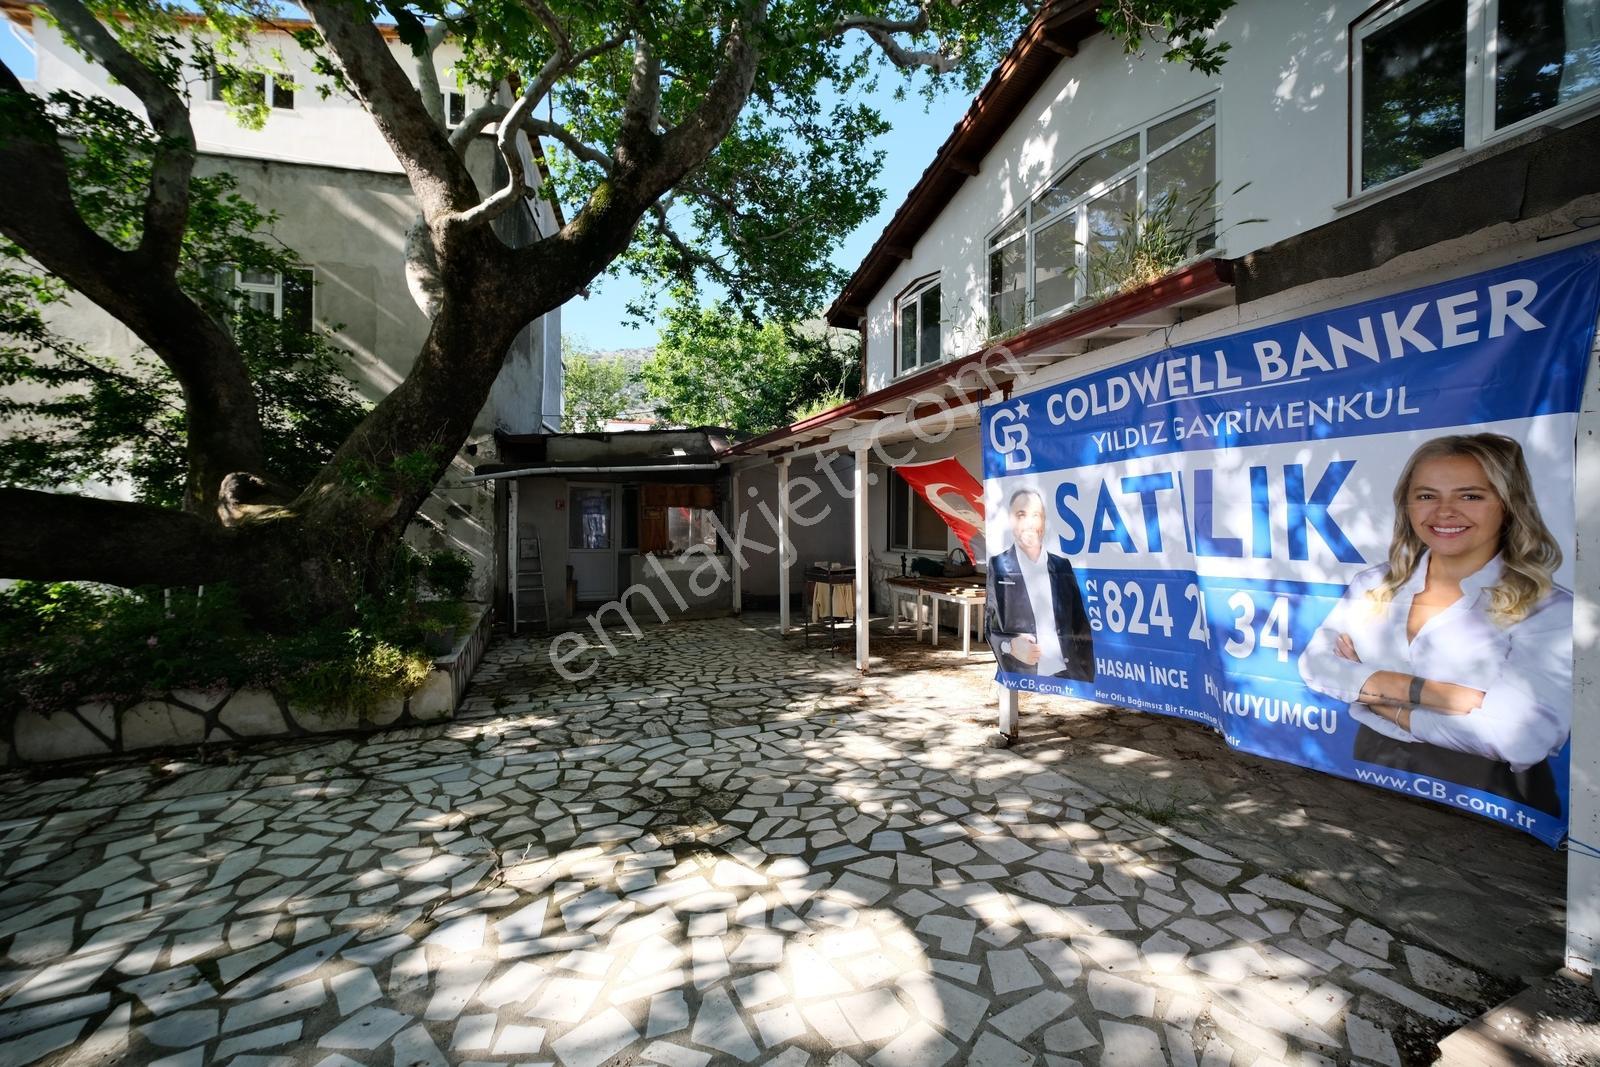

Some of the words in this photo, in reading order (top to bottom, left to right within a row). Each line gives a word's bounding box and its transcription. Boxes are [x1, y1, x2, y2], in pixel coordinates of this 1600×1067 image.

[1046, 350, 1243, 426] COLDWELL
[1260, 278, 1546, 383] BANKER
[1092, 421, 1168, 454] YILDIZ
[1174, 386, 1420, 441] GAYRİMENKUL
[1086, 579, 1103, 632] 0212
[1102, 580, 1174, 638] 824
[1224, 591, 1293, 663] 34
[1096, 657, 1146, 683] HASAN
[1150, 661, 1189, 690] İNCE
[1095, 689, 1108, 700] Her
[1110, 692, 1126, 704] Ofis
[1127, 696, 1163, 711] Bağımsız
[1165, 703, 1178, 713] Bir
[1179, 706, 1218, 724] Franchise
[1222, 690, 1338, 735] KUYUMCU
[1355, 767, 1536, 830] www.CB.com.tr
